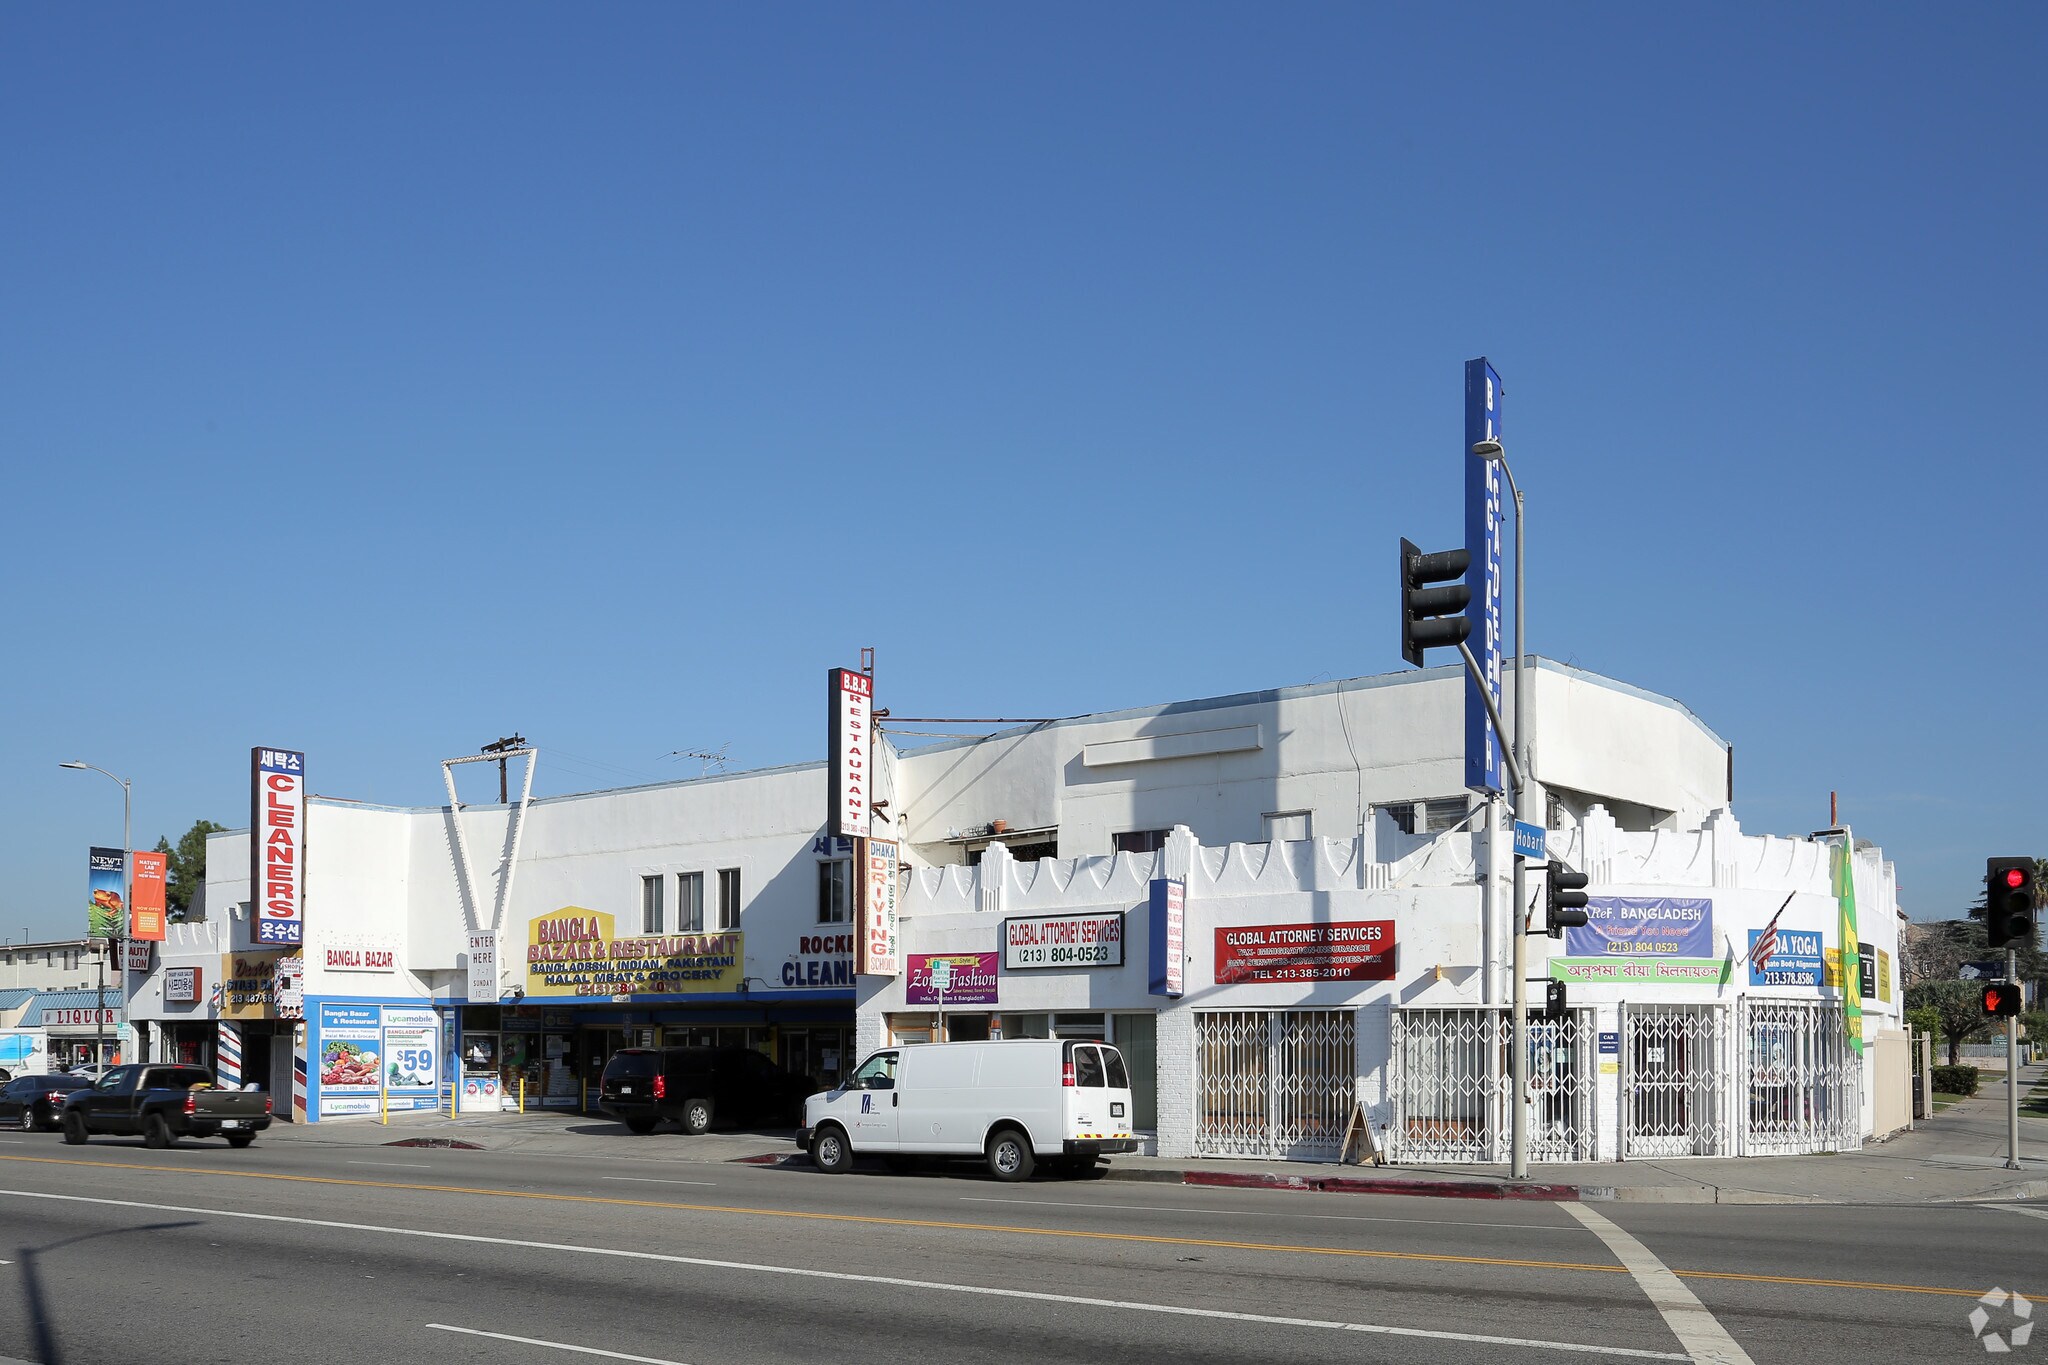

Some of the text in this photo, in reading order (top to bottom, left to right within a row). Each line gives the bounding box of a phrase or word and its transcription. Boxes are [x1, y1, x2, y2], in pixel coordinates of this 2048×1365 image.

[844, 673, 870, 695] B.B.R.
[260, 750, 300, 770] 세탁소
[848, 694, 862, 820] RESTAURANT
[267, 774, 294, 918] CLEANERS
[1516, 828, 1544, 852] Hobart
[870, 842, 895, 859] DHAKA
[91, 856, 122, 866] NEWT
[871, 857, 887, 956] DRIVING
[1621, 908, 1701, 921] BANGLADESH
[261, 921, 300, 941] 옷수선
[538, 916, 600, 943] BANGLA
[1010, 918, 1120, 946] GLOBAL ATTORNEY SERVICES
[1226, 926, 1382, 946] GLOBAL ATTORNEY SERVICES
[1595, 925, 1689, 937] A Friend You Need
[470, 936, 494, 948] ENTER
[527, 935, 739, 962] BAZAR & RESTAURANT
[1606, 941, 1678, 953] (213) 804 0523
[1790, 935, 1818, 955] YOGA
[119, 946, 149, 957] BAUTY
[327, 949, 393, 967] BANGLA BAZAR
[473, 952, 492, 964] HERE
[1019, 945, 1108, 963] (213) 804-0523
[121, 958, 147, 968] ALON
[616, 958, 663, 971] INDIAN,
[667, 956, 736, 969] PAKISTANI
[870, 957, 896, 972] SCHOOL
[1567, 963, 1618, 980] অনুপমা
[1656, 961, 1720, 977] মিলনায়তন
[1781, 959, 1821, 969] Body Alignment
[545, 969, 723, 986] HALAL MEAT & GROCERY
[943, 968, 996, 993] Fashion
[1253, 970, 1273, 979] TEL
[1276, 967, 1351, 979] 213-385-2010
[1765, 972, 1814, 985] 213.378.8586
[576, 983, 611, 996] (213)
[613, 982, 637, 995] 380
[231, 994, 243, 1003] 213
[57, 1009, 114, 1024] LIQUOR
[388, 1015, 433, 1023] Lycamobile
[397, 1049, 433, 1071] $59
[331, 1102, 370, 1110] Lycamobile
